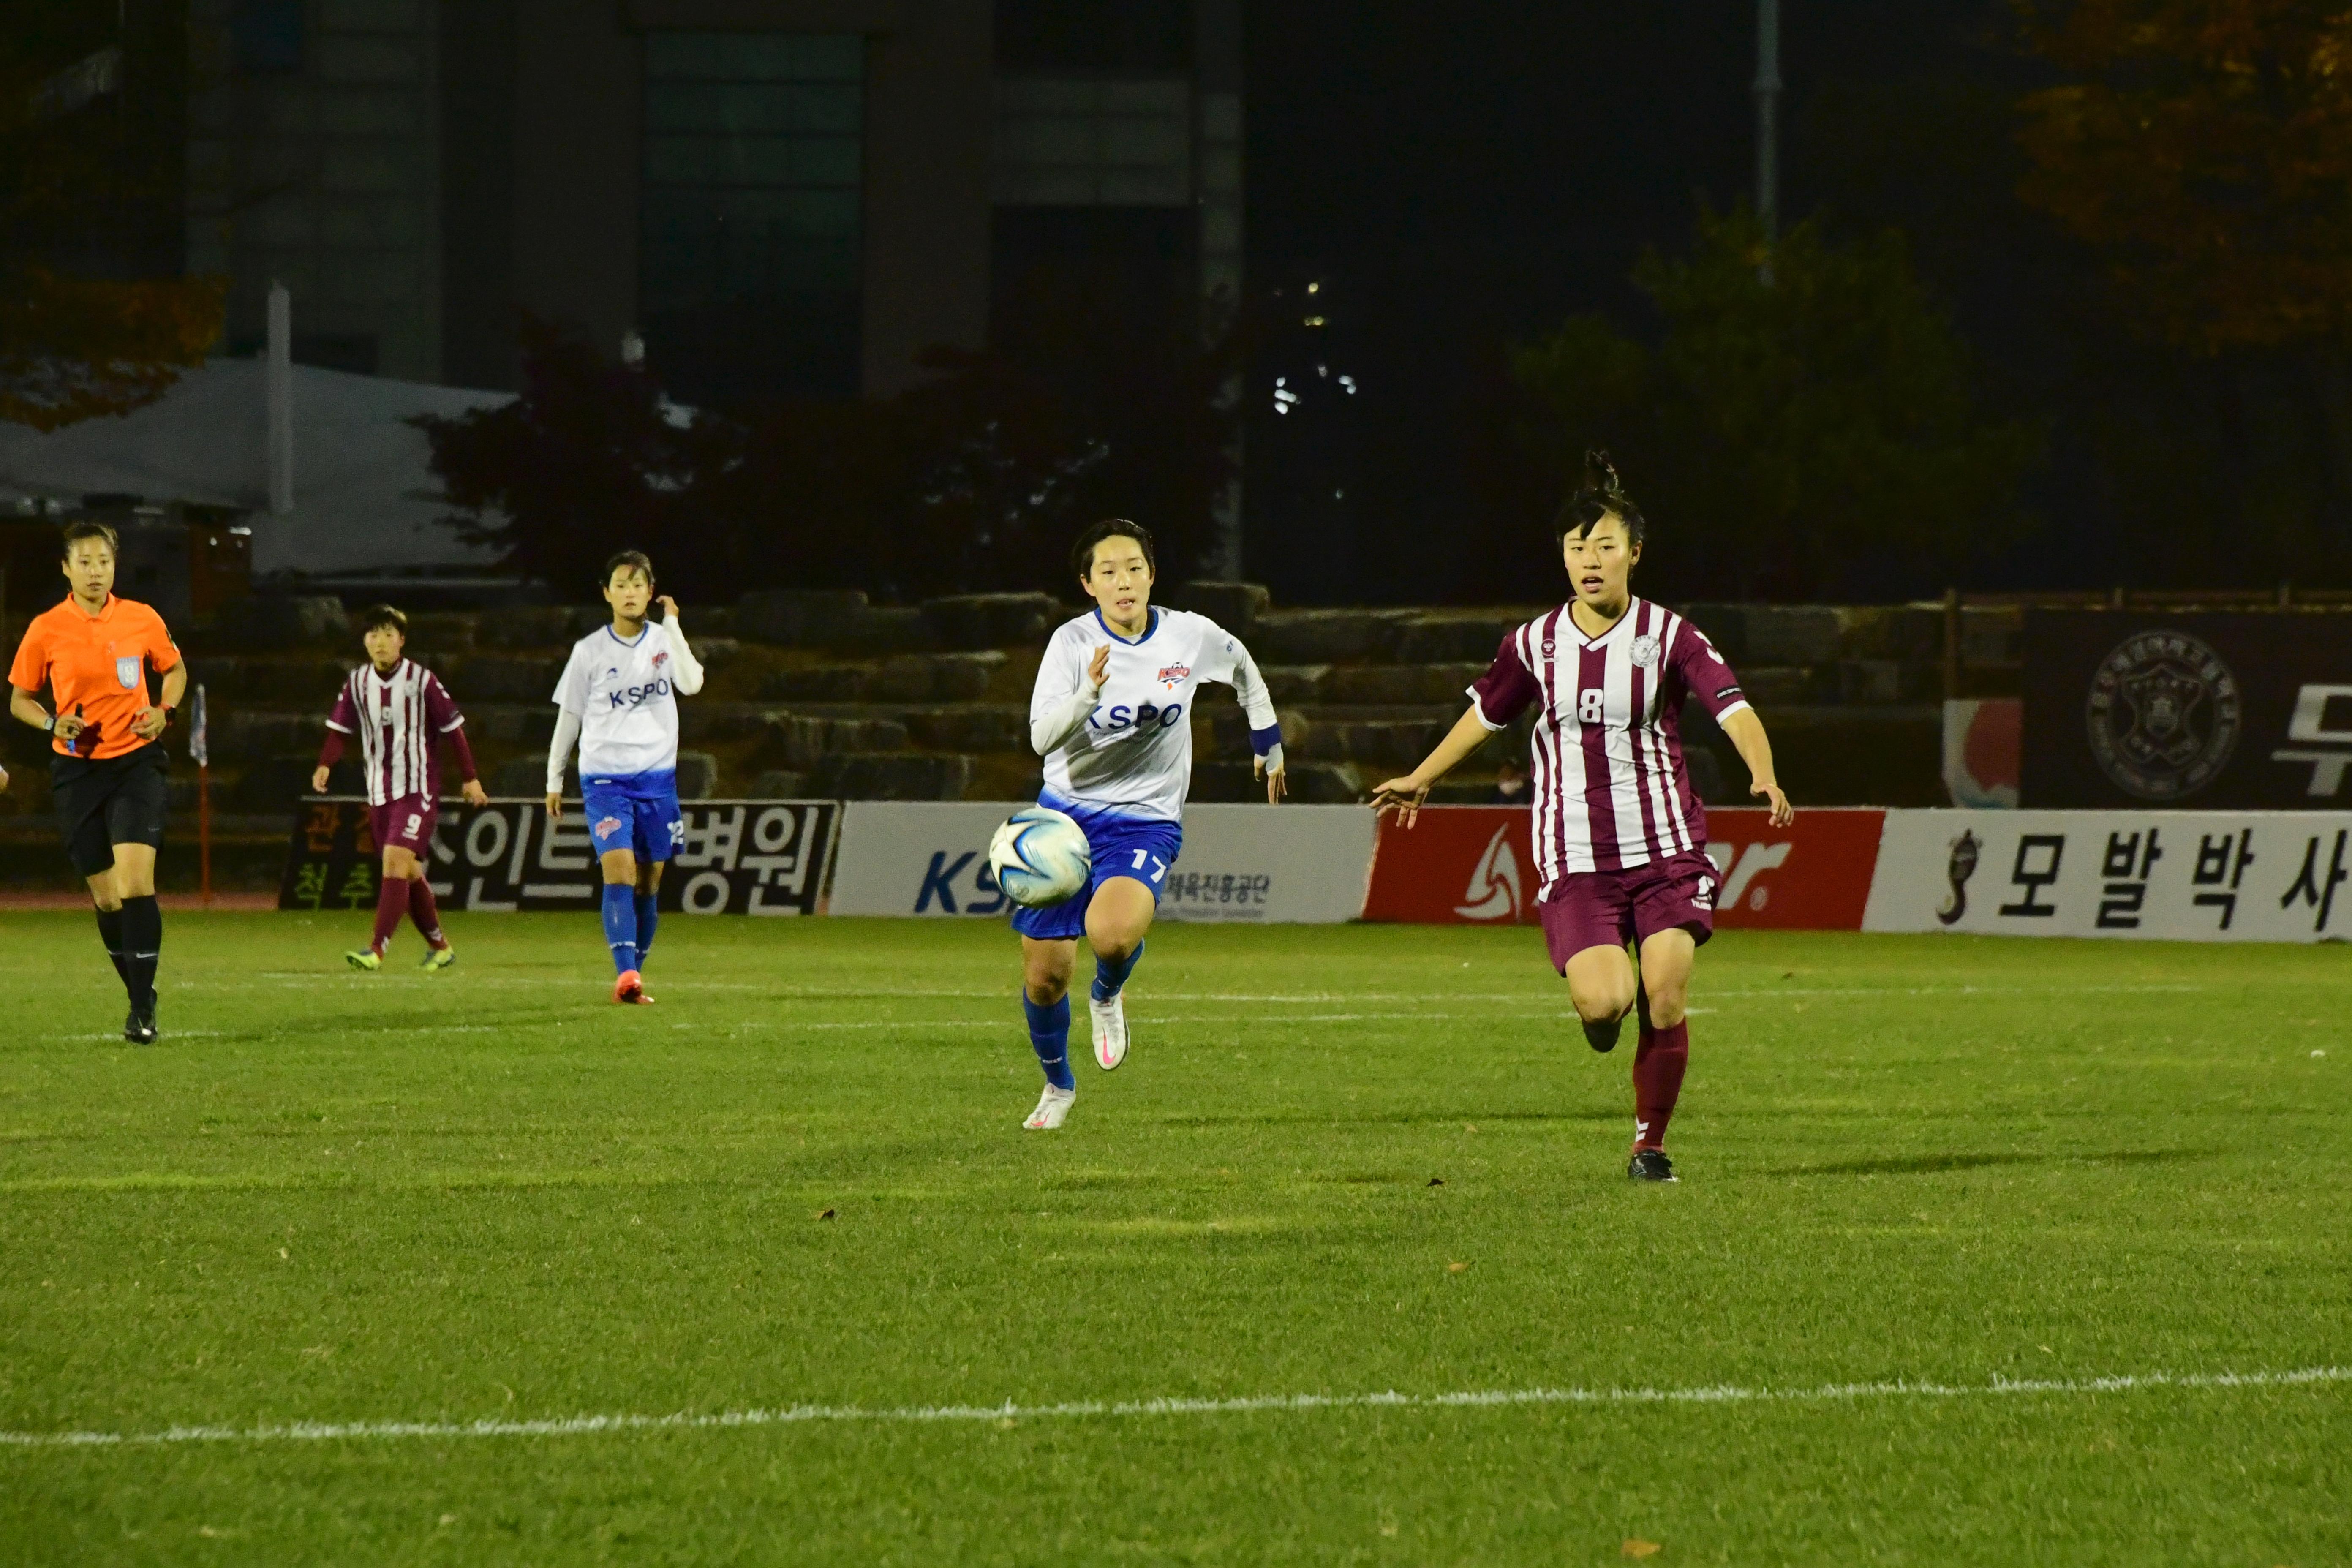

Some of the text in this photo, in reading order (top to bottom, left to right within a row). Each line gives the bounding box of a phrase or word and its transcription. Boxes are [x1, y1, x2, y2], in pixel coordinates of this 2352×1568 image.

[610, 678, 668, 709] KSPO
[1579, 688, 1604, 723] 8
[403, 813, 422, 834] 9
[674, 806, 820, 915] 병원
[1131, 849, 1167, 884] 17
[914, 851, 1019, 913] KS
